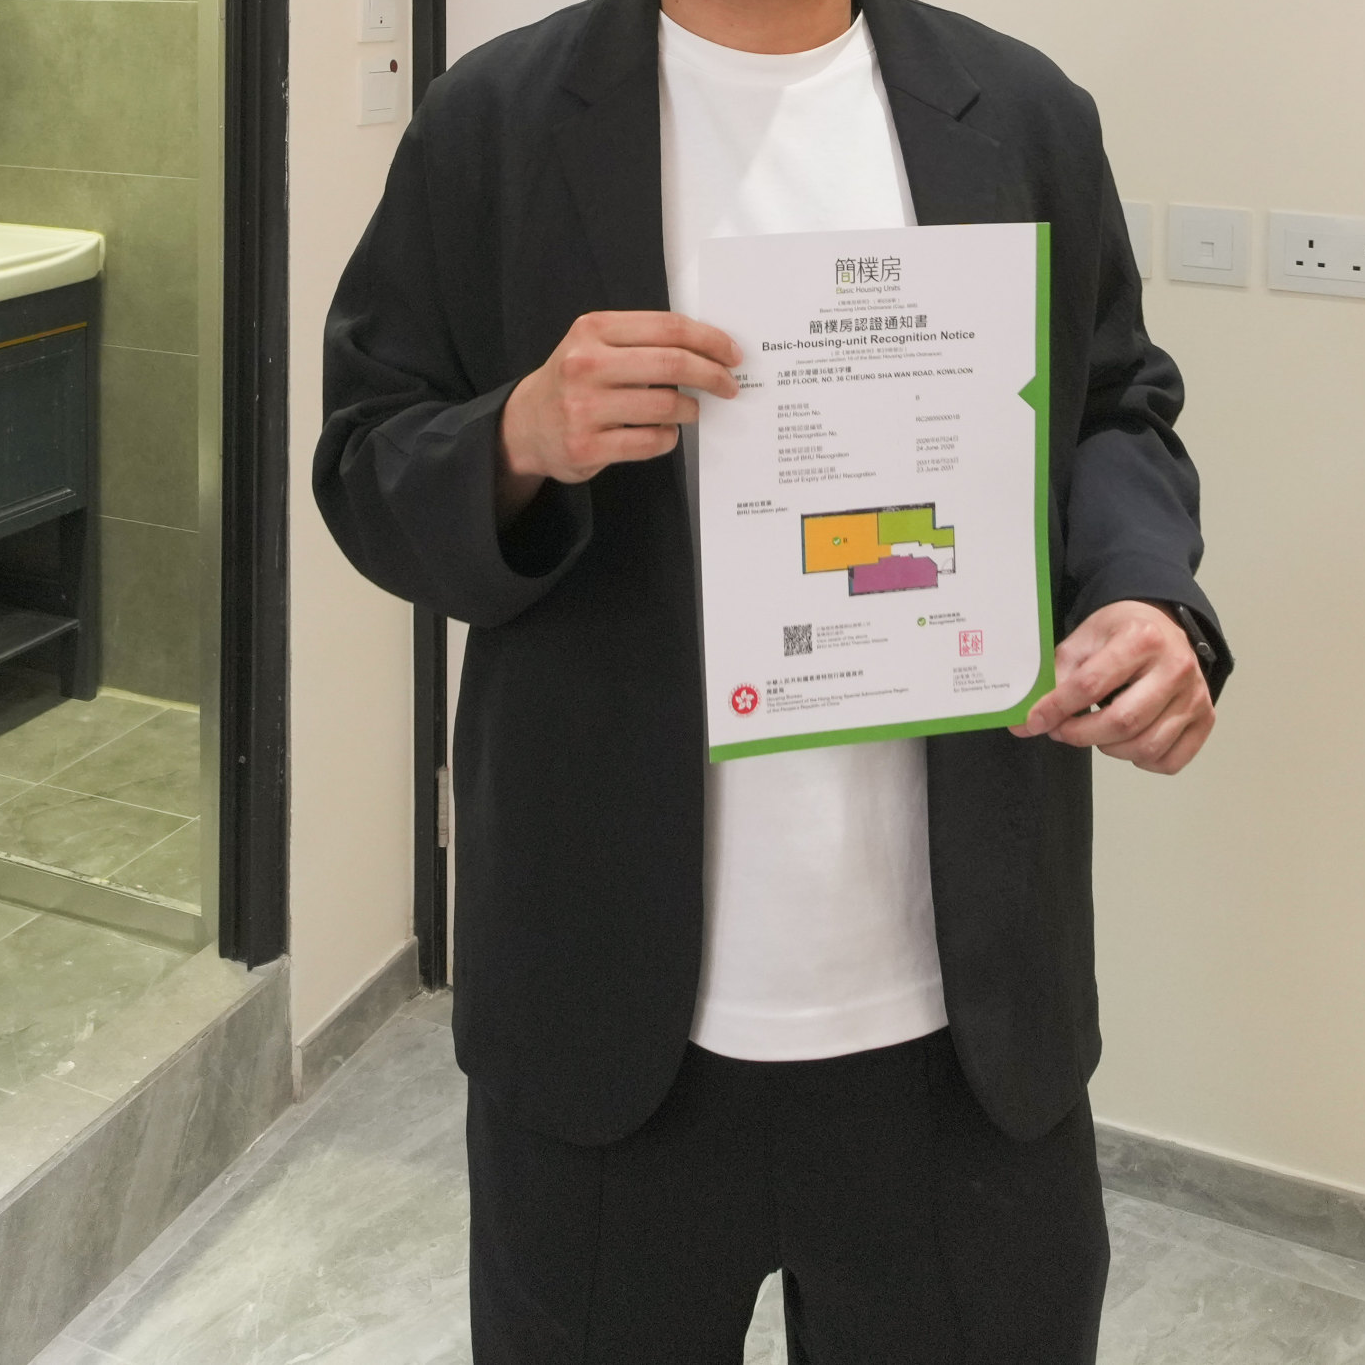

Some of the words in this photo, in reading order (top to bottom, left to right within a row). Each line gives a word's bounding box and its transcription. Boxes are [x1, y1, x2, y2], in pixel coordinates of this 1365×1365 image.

[835, 255, 901, 285] 簡樸房
[855, 286, 882, 294] Housing
[809, 314, 927, 335] 簡樸房認證通知書
[762, 336, 867, 351] Basic-housing-unit
[870, 332, 937, 344] Recognition
[940, 330, 975, 340] Notice
[845, 373, 876, 381] CHEUNG
